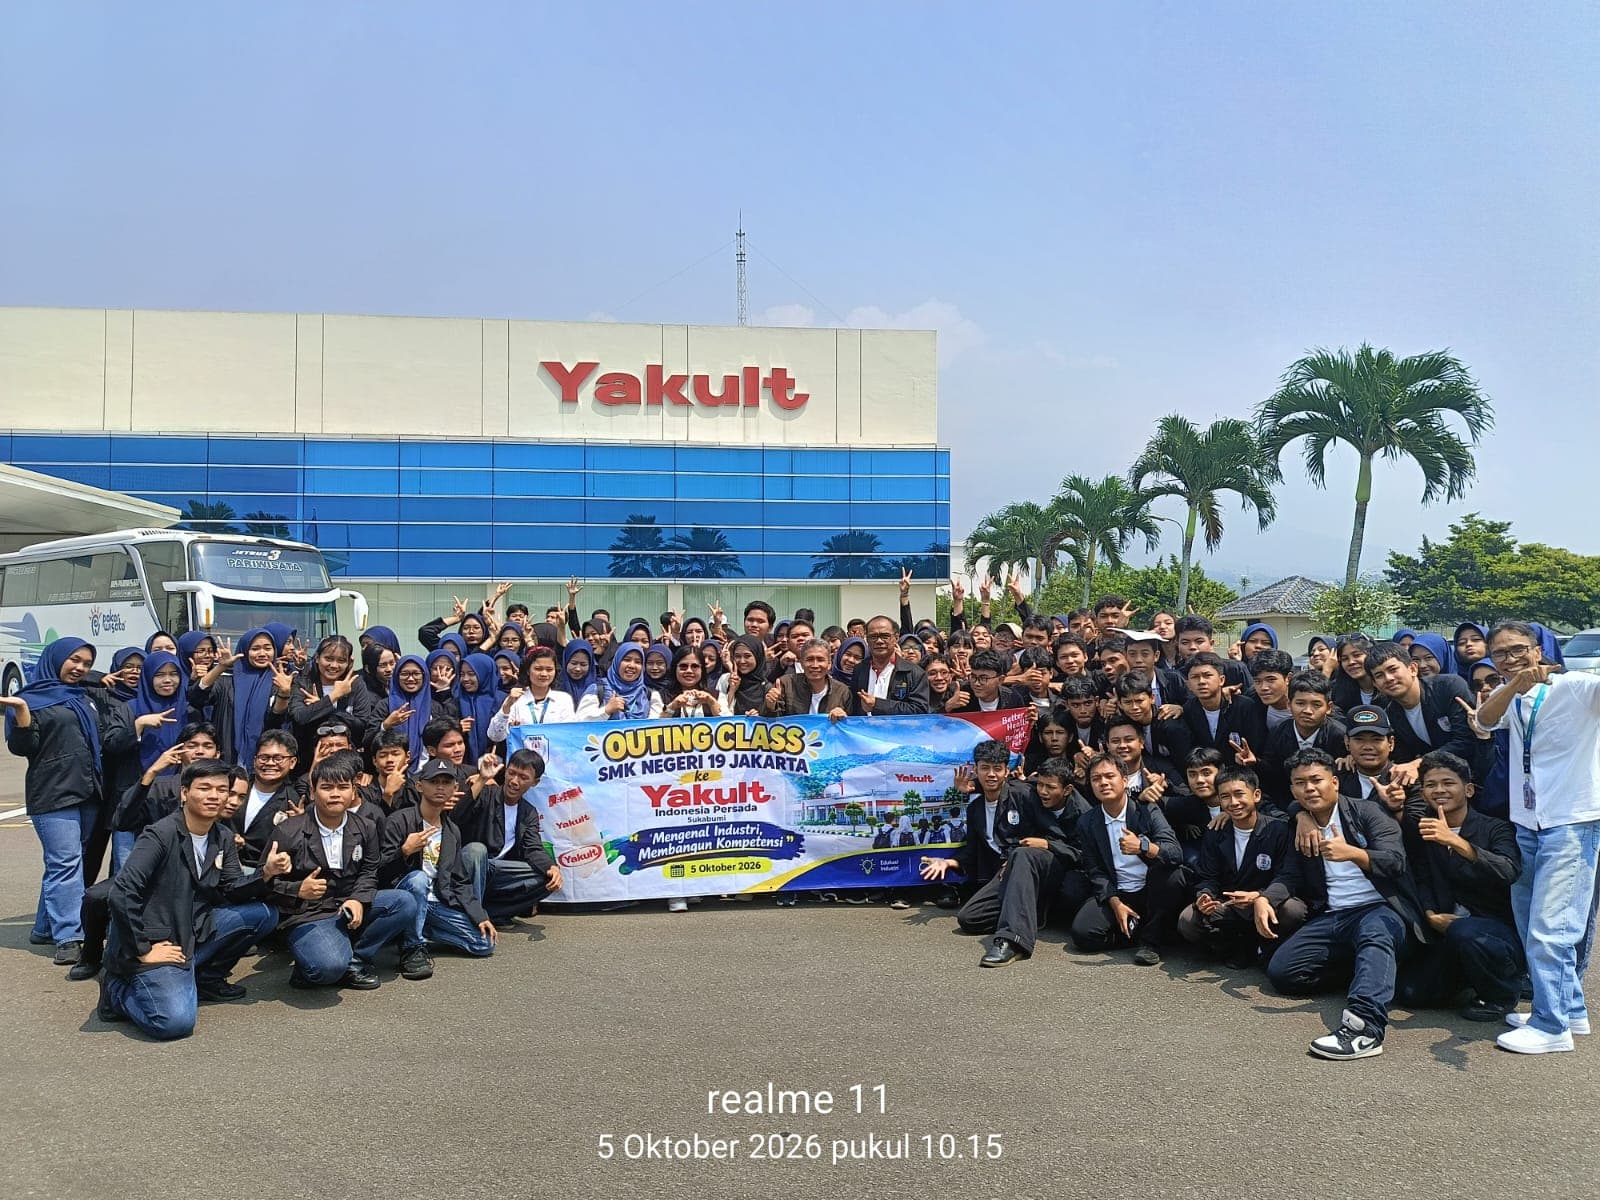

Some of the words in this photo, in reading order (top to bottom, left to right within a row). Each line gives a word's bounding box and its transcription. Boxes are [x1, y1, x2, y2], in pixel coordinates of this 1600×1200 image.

[540, 361, 810, 410] Yakult
[226, 558, 303, 572] PARIWISATA
[1001, 712, 1025, 725] Better
[603, 723, 712, 762] OUTING
[714, 722, 806, 754] CLASS
[598, 763, 637, 782] SMK
[641, 755, 704, 775] NEGERI
[708, 754, 726, 769] 19
[729, 754, 809, 774] JAKARTA
[694, 769, 709, 782] ke
[895, 773, 935, 784] Yakult
[640, 781, 772, 808] Yakult
[655, 808, 710, 817] Indonesia
[713, 804, 758, 814] Persada
[556, 814, 590, 830] Yakult
[687, 815, 727, 824] Sukabumi
[714, 823, 763, 837] Industri,
[564, 848, 598, 864] Yakult
[638, 841, 713, 862] Membangun
[690, 864, 697, 873] 5
[699, 863, 736, 873] Oktober
[738, 861, 762, 871] 2026
